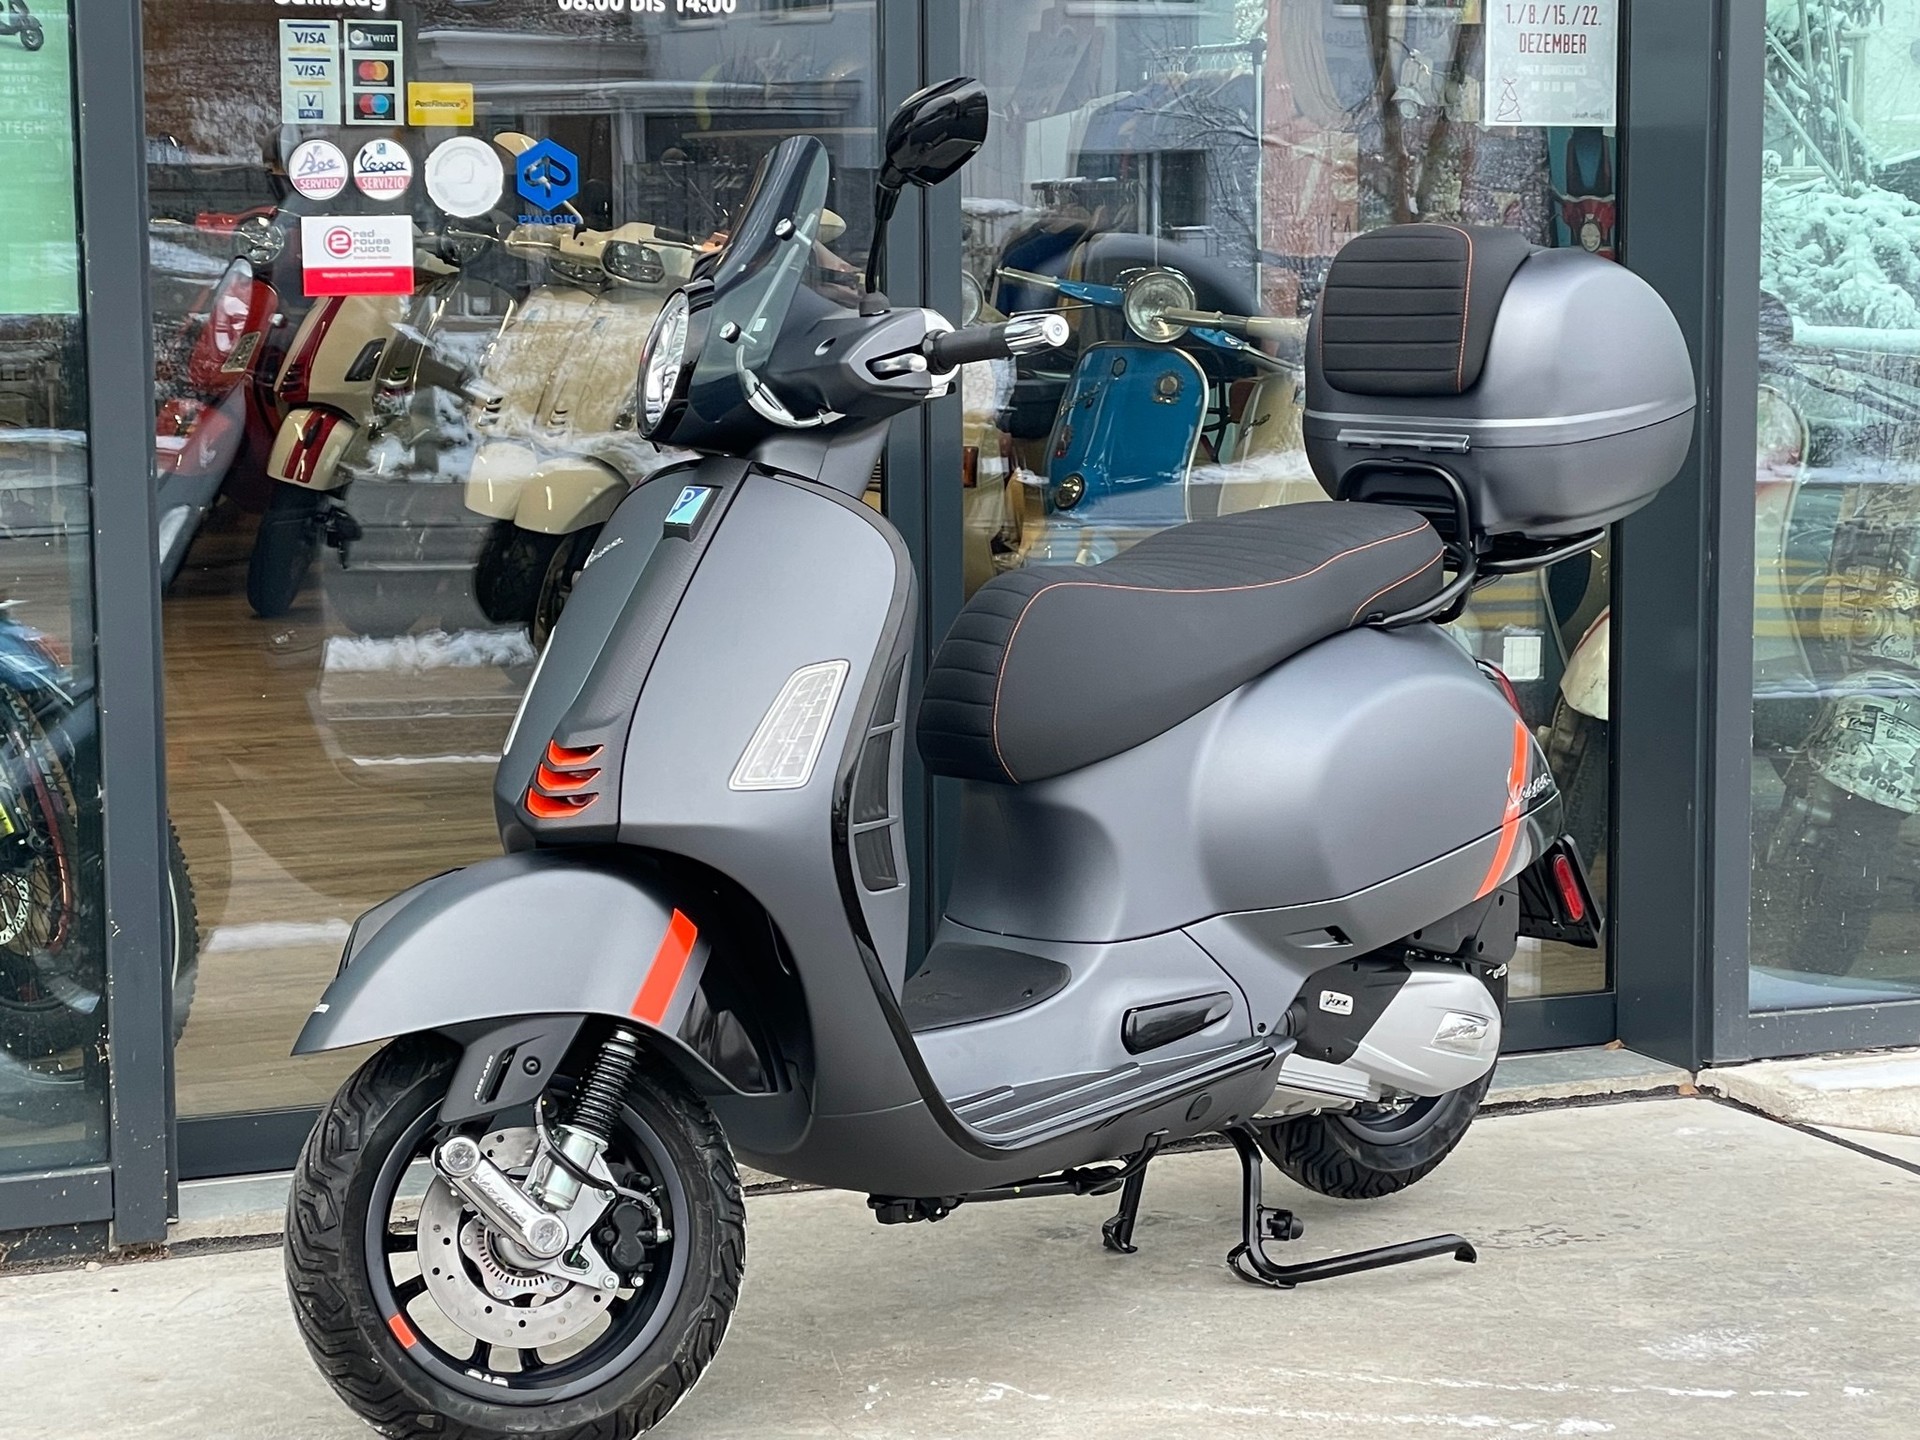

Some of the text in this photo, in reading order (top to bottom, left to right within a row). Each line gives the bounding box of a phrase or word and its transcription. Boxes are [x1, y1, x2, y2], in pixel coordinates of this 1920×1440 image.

[292, 31, 326, 44] VISA
[366, 33, 396, 43] TWINT
[1519, 33, 1587, 54] DEZEMBER
[294, 64, 326, 77] VISA
[303, 110, 318, 118] PAY
[358, 149, 407, 174] Vespa
[300, 178, 340, 189] SERVIZIO
[362, 177, 405, 190] SERVIZIO
[518, 214, 579, 224] PIAGGIO
[353, 229, 375, 238] rad
[353, 245, 390, 253] ruote
